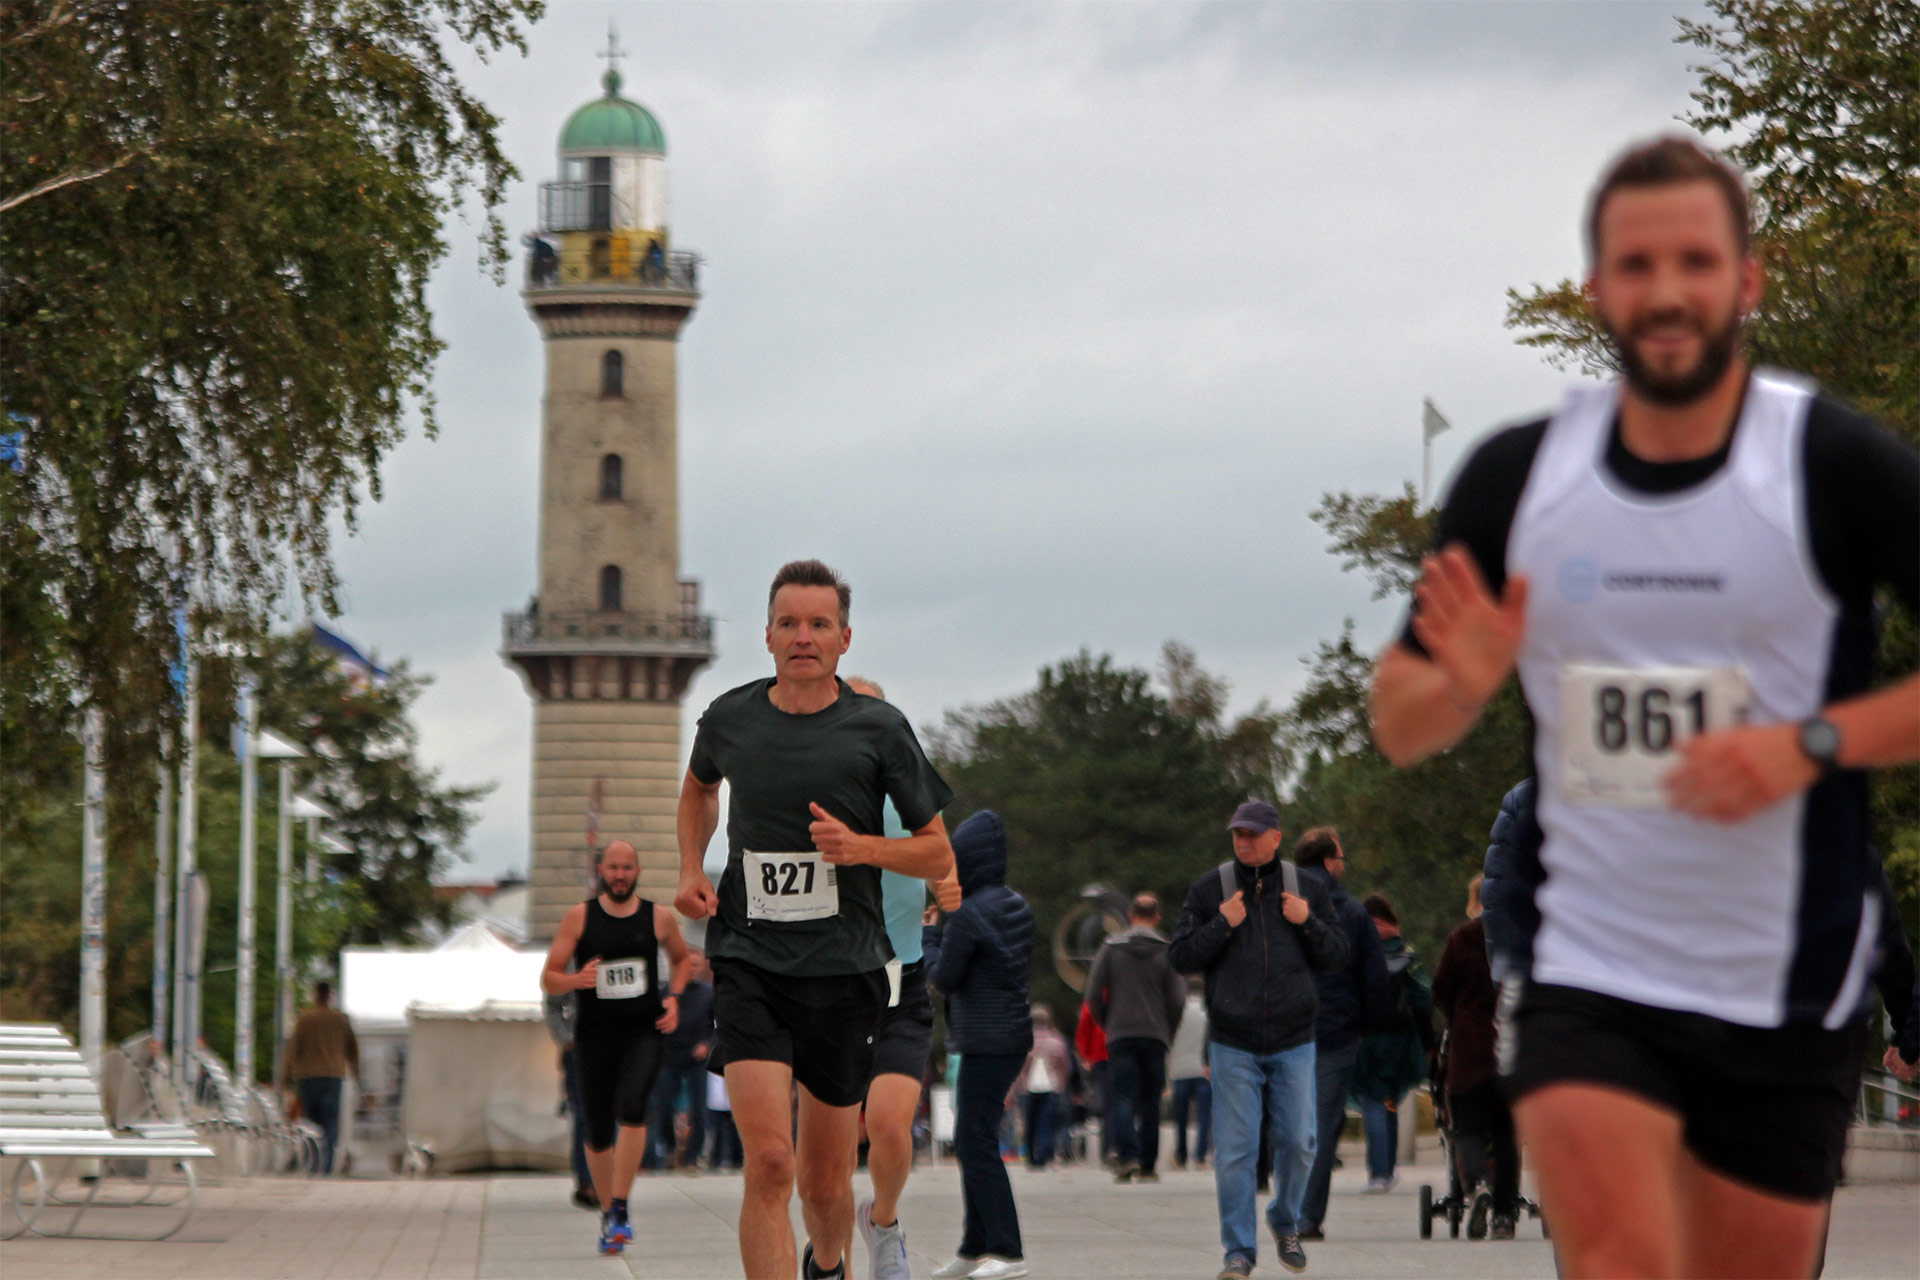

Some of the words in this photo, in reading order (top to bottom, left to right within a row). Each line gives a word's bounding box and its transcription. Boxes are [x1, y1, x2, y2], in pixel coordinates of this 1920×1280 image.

[1597, 685, 1706, 754] 861
[761, 862, 814, 896] 827
[606, 967, 634, 987] 818
